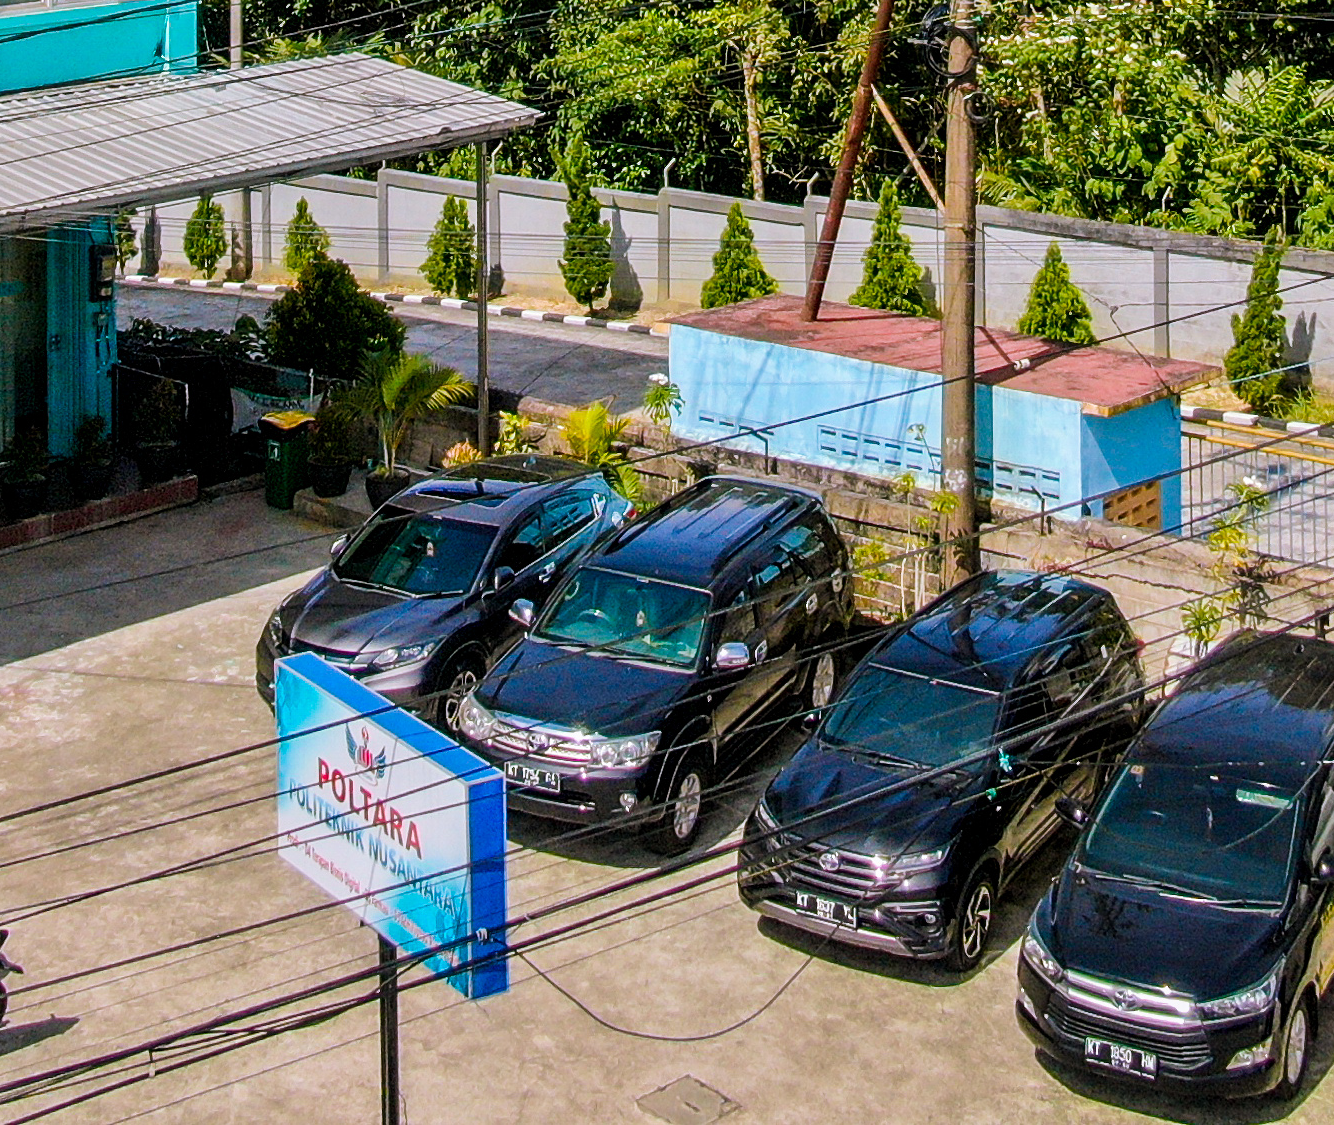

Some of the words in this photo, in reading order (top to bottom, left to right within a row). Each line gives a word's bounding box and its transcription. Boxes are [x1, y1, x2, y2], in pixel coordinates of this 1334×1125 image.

[289, 777, 365, 854] POLITEKNIK
[368, 835, 457, 922] NUSANTARA
[317, 756, 424, 862] POLTARA
[1087, 1037, 1100, 1056] KT
